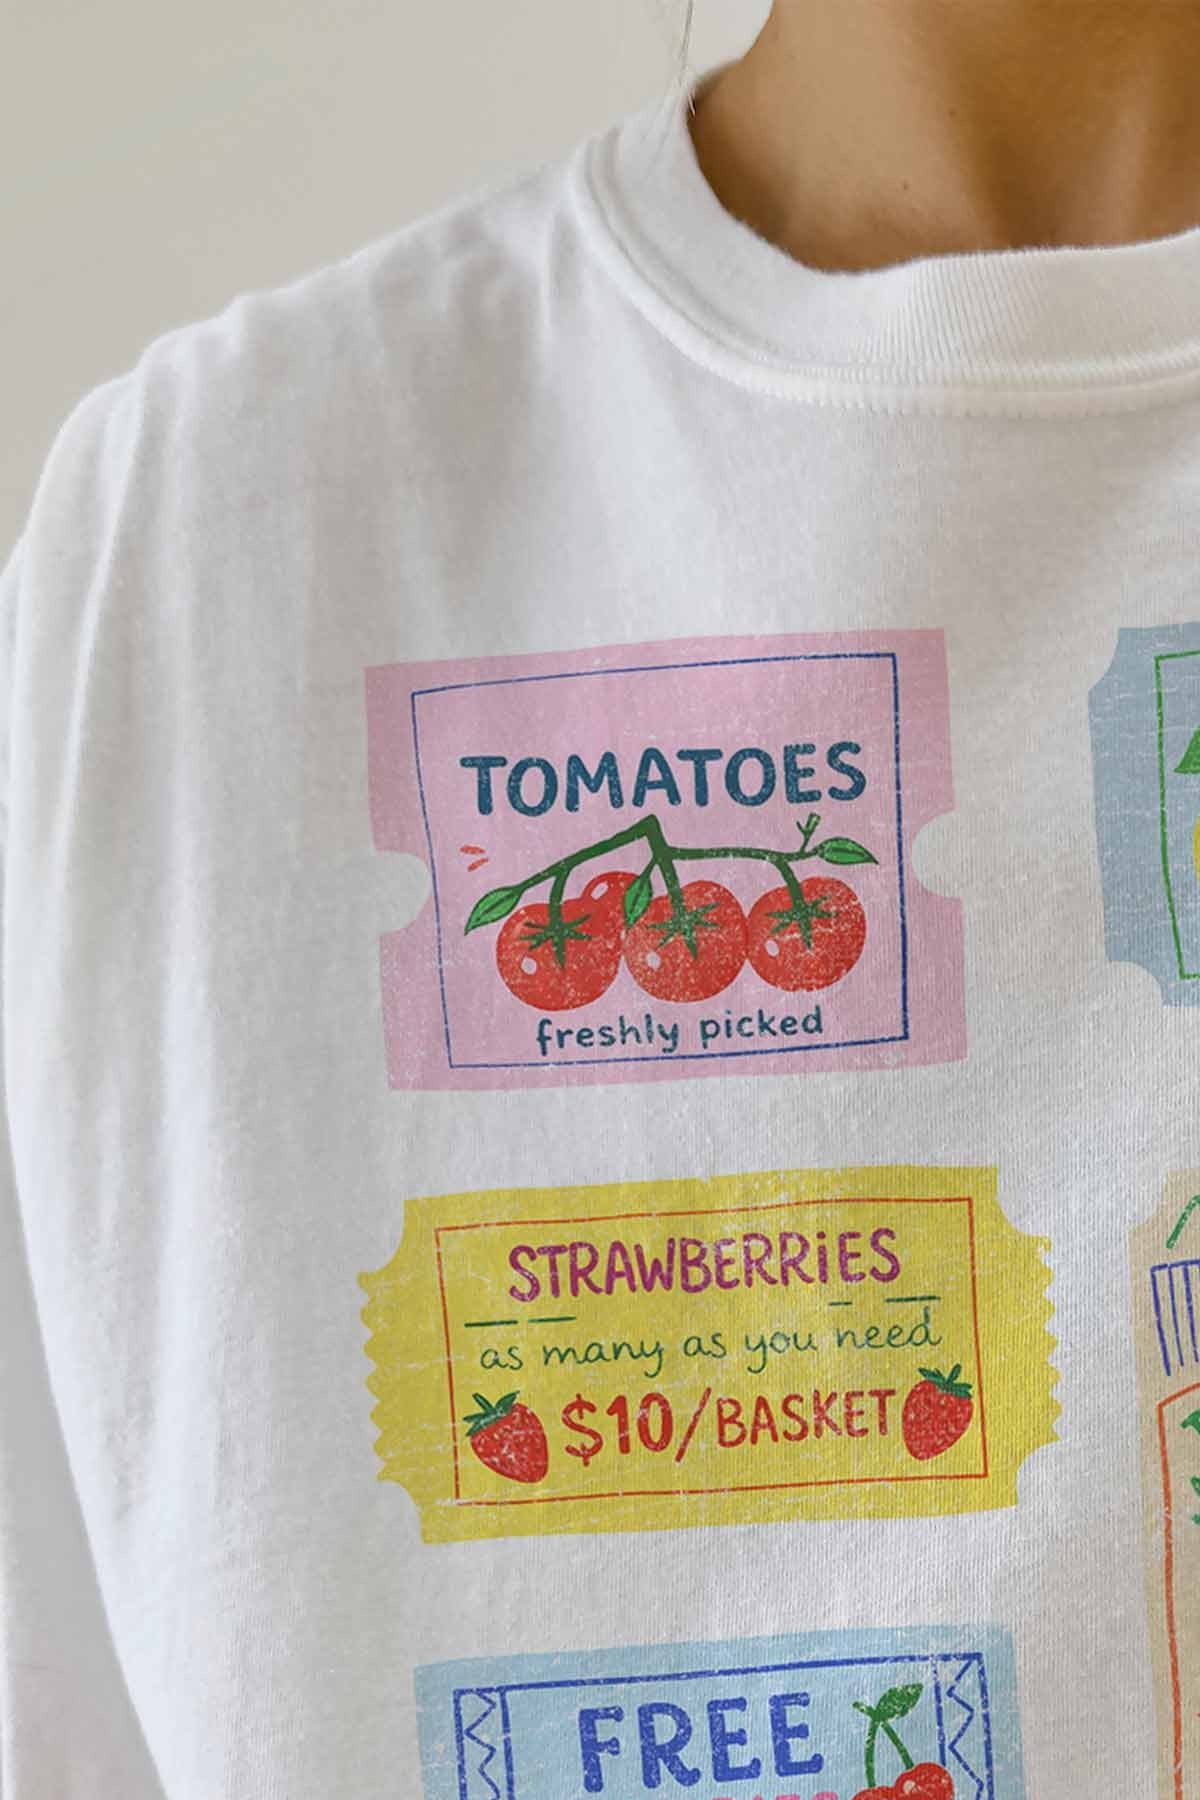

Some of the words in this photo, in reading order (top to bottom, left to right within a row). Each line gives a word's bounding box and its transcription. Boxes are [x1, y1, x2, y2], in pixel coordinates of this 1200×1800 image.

[459, 741, 867, 816] TOMATOES
[535, 1013, 680, 1056] freshly
[699, 1005, 825, 1045] picked
[479, 1344, 524, 1371] as
[541, 1339, 665, 1377] many
[682, 1332, 728, 1358] as
[744, 1328, 818, 1374] you
[834, 1306, 943, 1351] need
[577, 1692, 825, 1793] FREE
